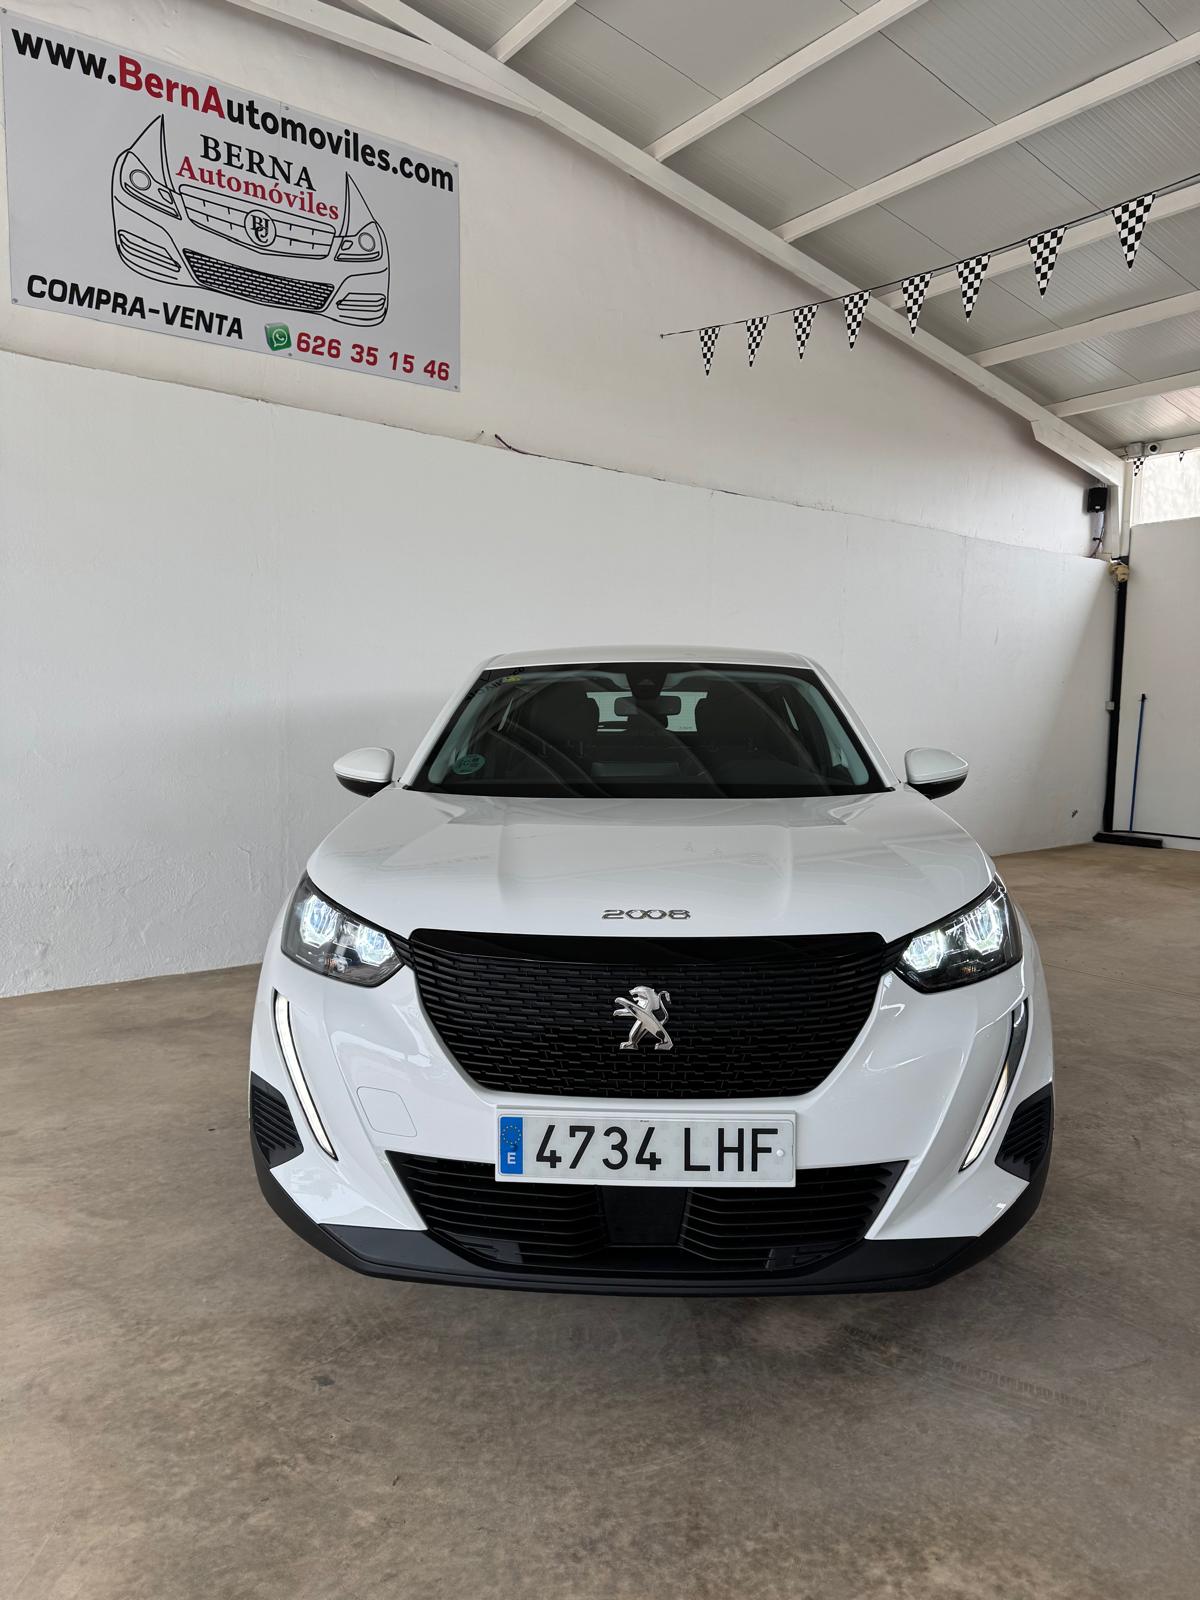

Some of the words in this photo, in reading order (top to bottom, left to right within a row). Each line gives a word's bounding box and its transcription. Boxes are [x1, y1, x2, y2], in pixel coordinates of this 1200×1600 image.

[11, 28, 454, 192] www.BernAutomoviles.com
[176, 156, 340, 220] Automóviles
[200, 134, 316, 191] BERNA
[27, 274, 243, 340] COMPRA-VENTA
[296, 332, 341, 359] 626
[351, 343, 378, 366] 35
[388, 352, 414, 374] 15
[423, 360, 450, 381] 46
[602, 909, 691, 920] 2008
[507, 1152, 516, 1164] E
[536, 1124, 662, 1171] 4734
[683, 1127, 778, 1172] LHF
